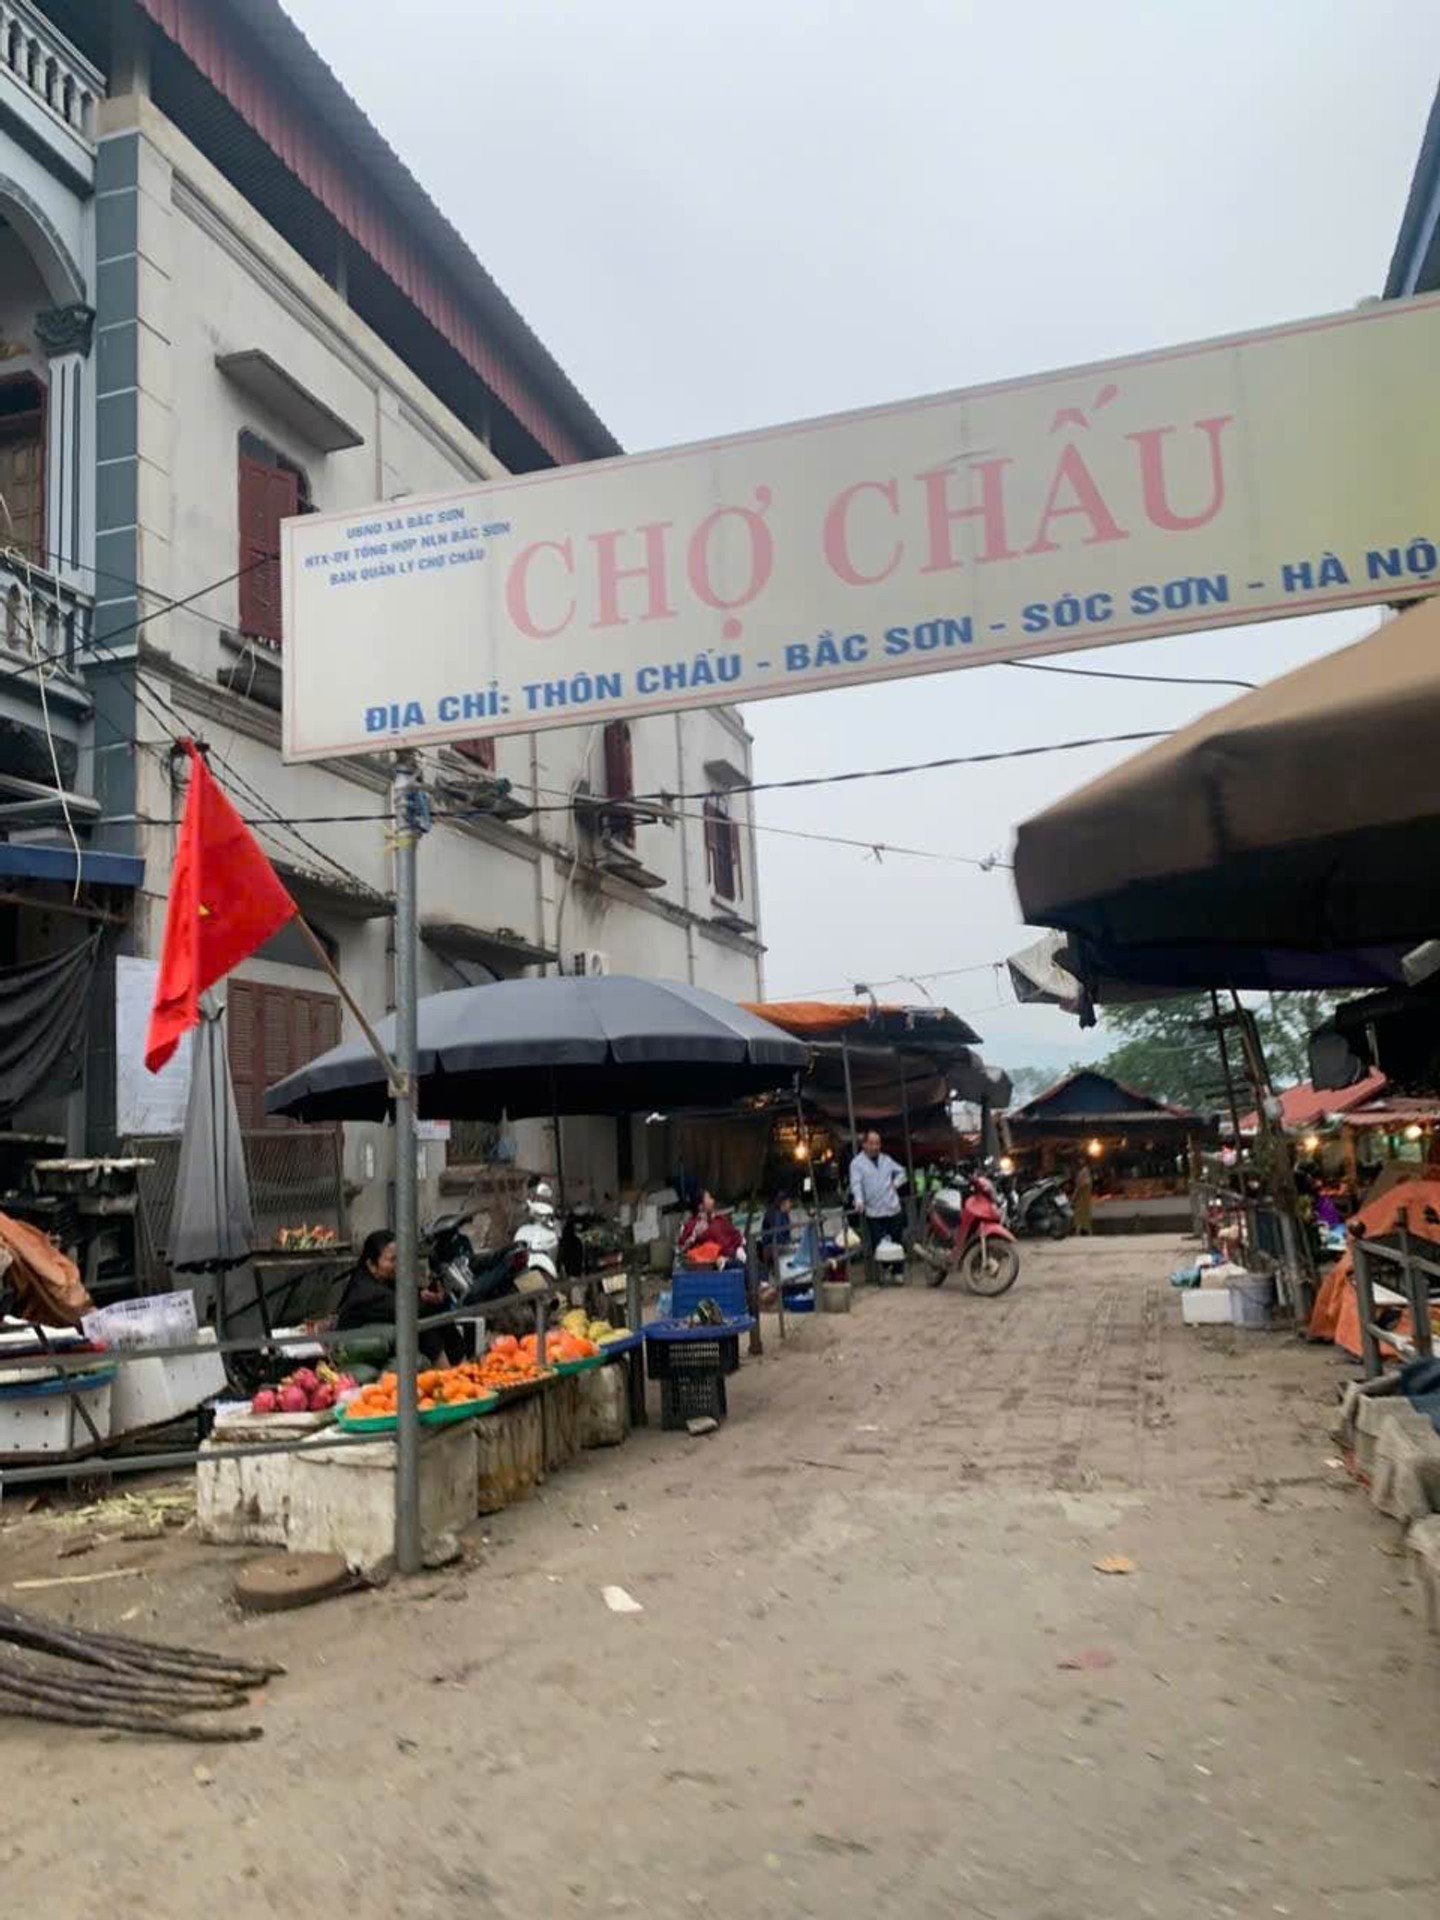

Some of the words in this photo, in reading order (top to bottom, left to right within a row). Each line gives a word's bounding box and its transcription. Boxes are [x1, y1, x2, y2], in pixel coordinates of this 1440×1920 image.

[330, 570, 357, 585] BAN
[506, 484, 774, 639] CHỢ
[822, 384, 1234, 586] CHẤU
[364, 701, 425, 734] ĐỊA
[438, 680, 510, 722] CHỈ:
[523, 671, 622, 710] THÔN
[636, 648, 742, 694] CHẤU
[884, 616, 973, 655] SƠN
[1021, 587, 1114, 634] SÓC
[1130, 574, 1229, 615] SƠN
[1282, 552, 1348, 592] HÀ
[1366, 537, 1438, 580] NỘ
